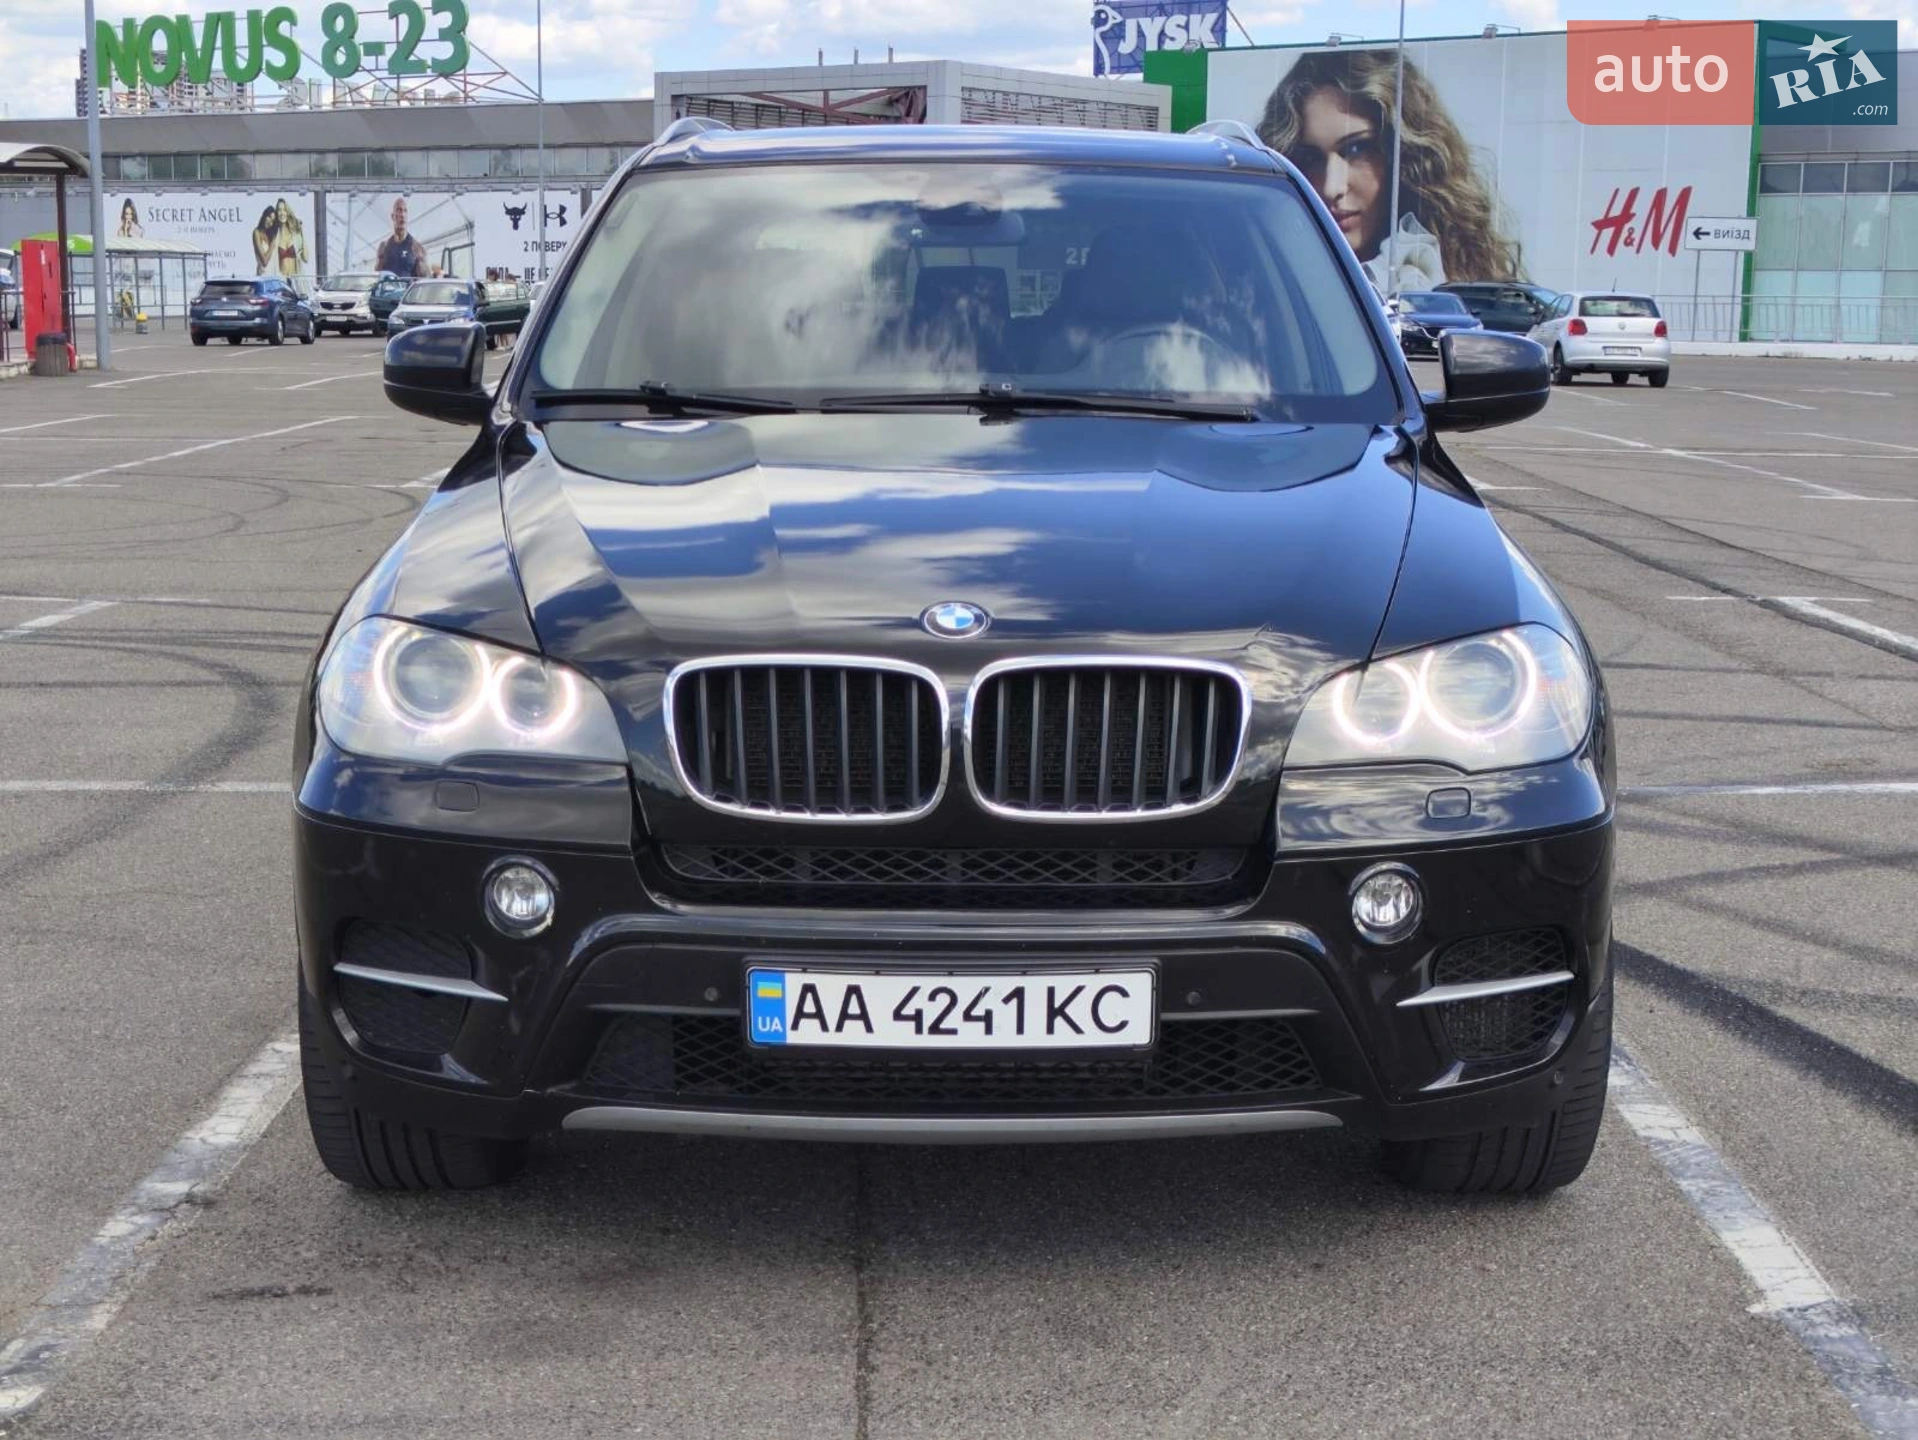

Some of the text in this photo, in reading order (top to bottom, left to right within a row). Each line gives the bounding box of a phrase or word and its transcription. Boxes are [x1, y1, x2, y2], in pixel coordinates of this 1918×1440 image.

[95, 0, 471, 89] NOVUS 8-23
[1117, 12, 1219, 55] JYSK
[1590, 185, 1693, 258] H&M
[758, 1016, 783, 1033] UA
[790, 982, 1132, 1036] AA 4241 KC
